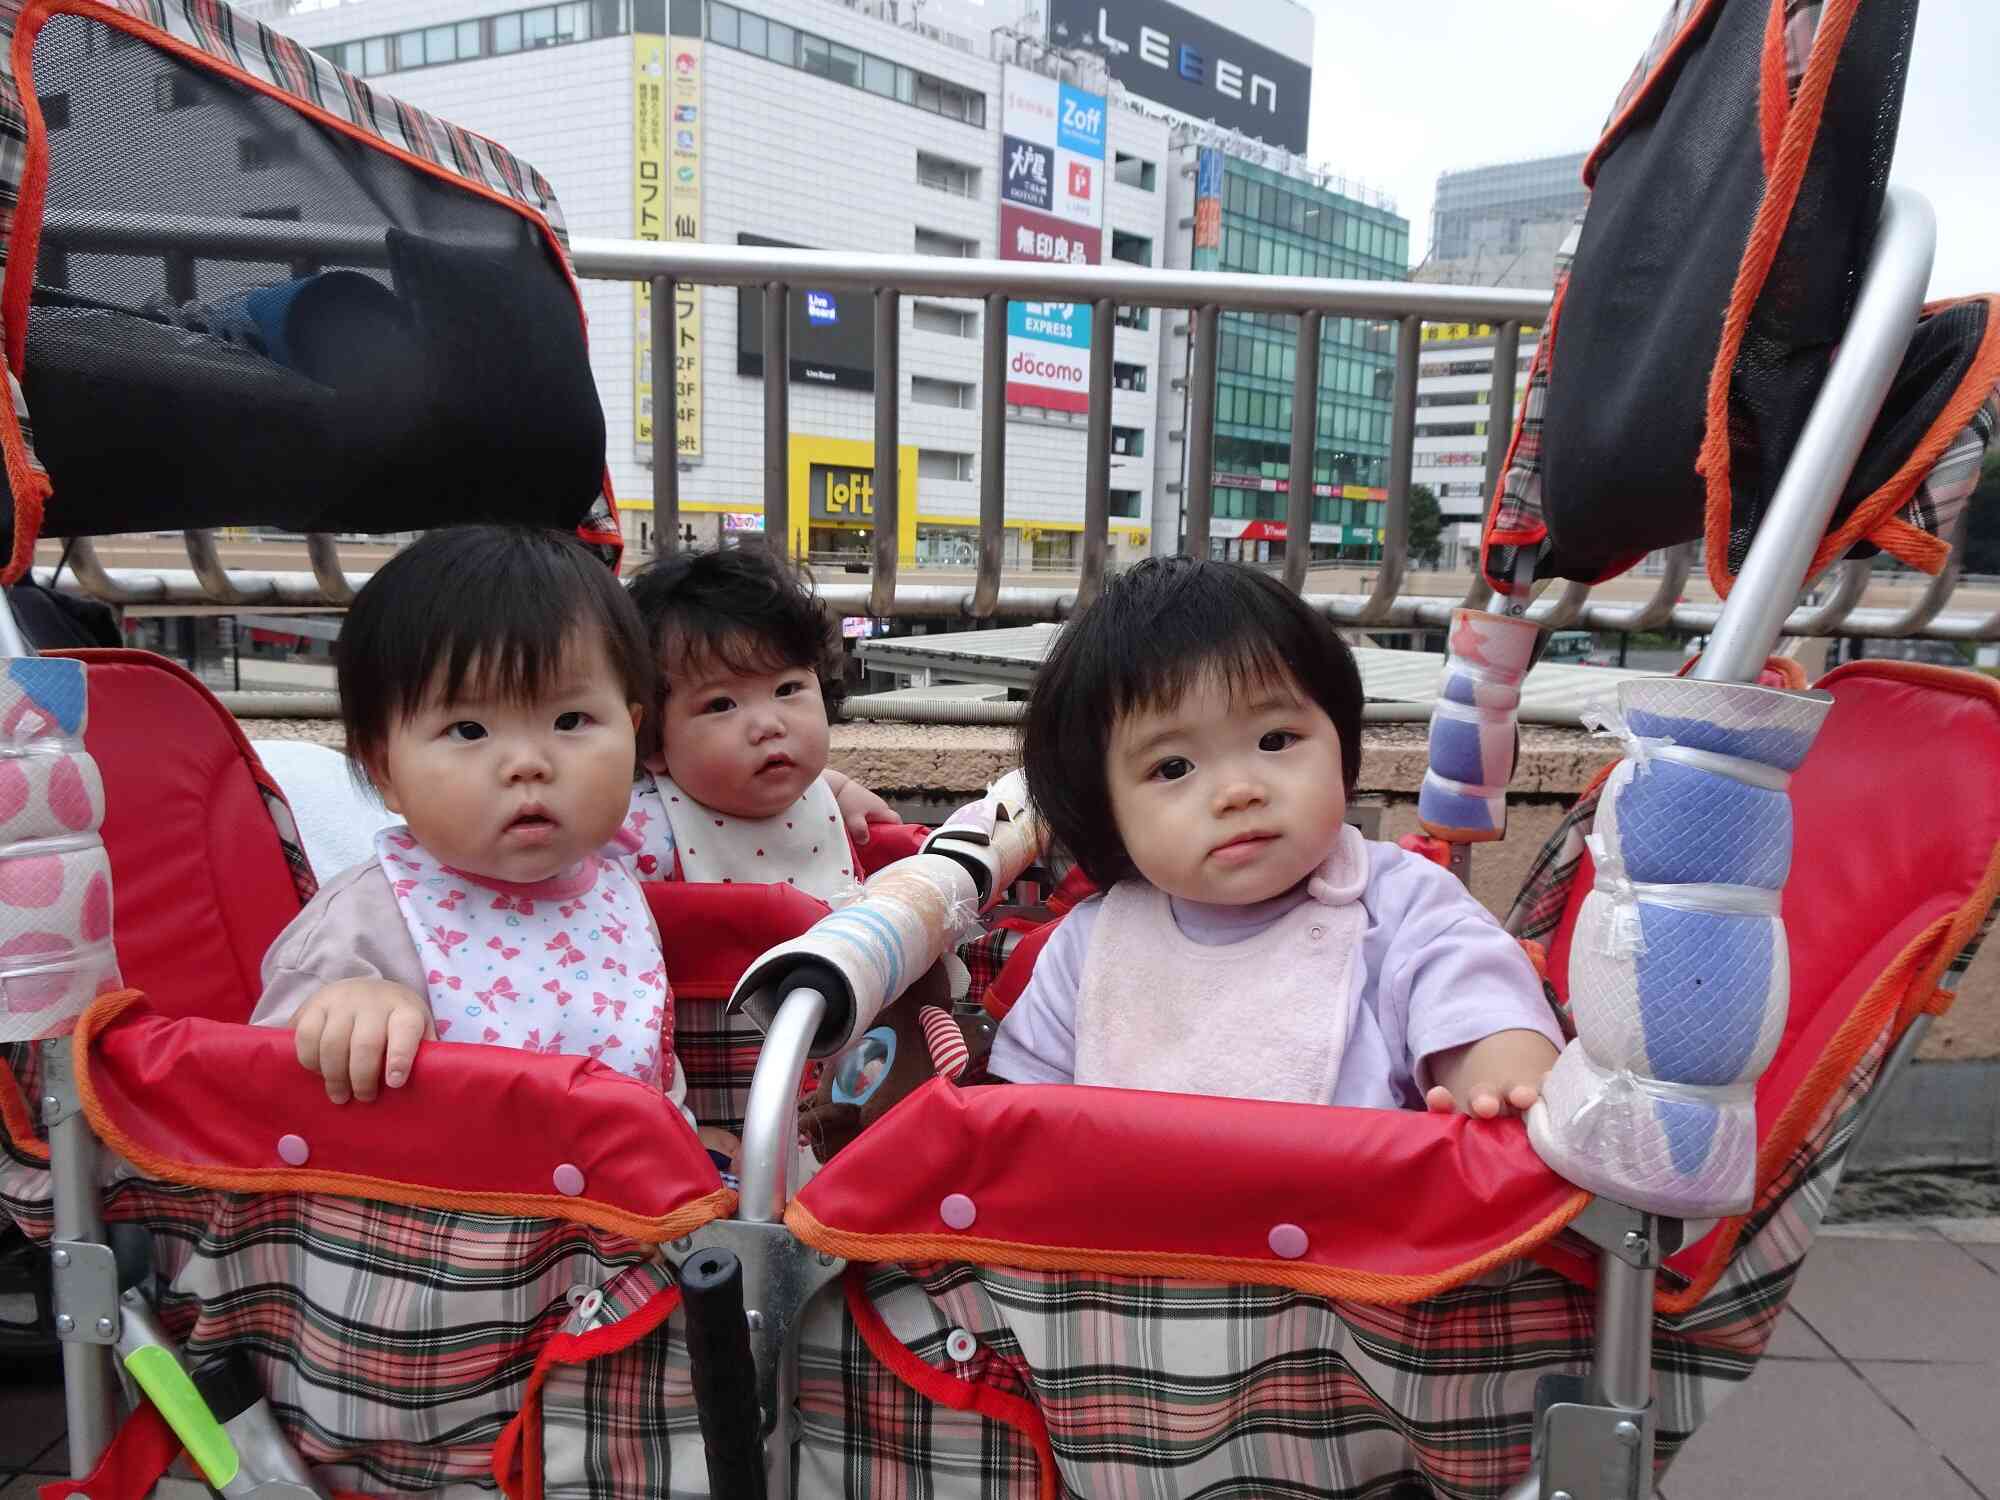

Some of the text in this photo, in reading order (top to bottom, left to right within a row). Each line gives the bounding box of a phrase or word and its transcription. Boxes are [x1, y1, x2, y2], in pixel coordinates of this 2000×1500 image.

[1063, 98, 1101, 135] Zoff
[1016, 226, 1087, 264] 無印良品
[1024, 316, 1073, 339] EXPRESS
[1012, 351, 1083, 382] docomo
[677, 434, 696, 450] oft
[826, 471, 875, 514] Loft
